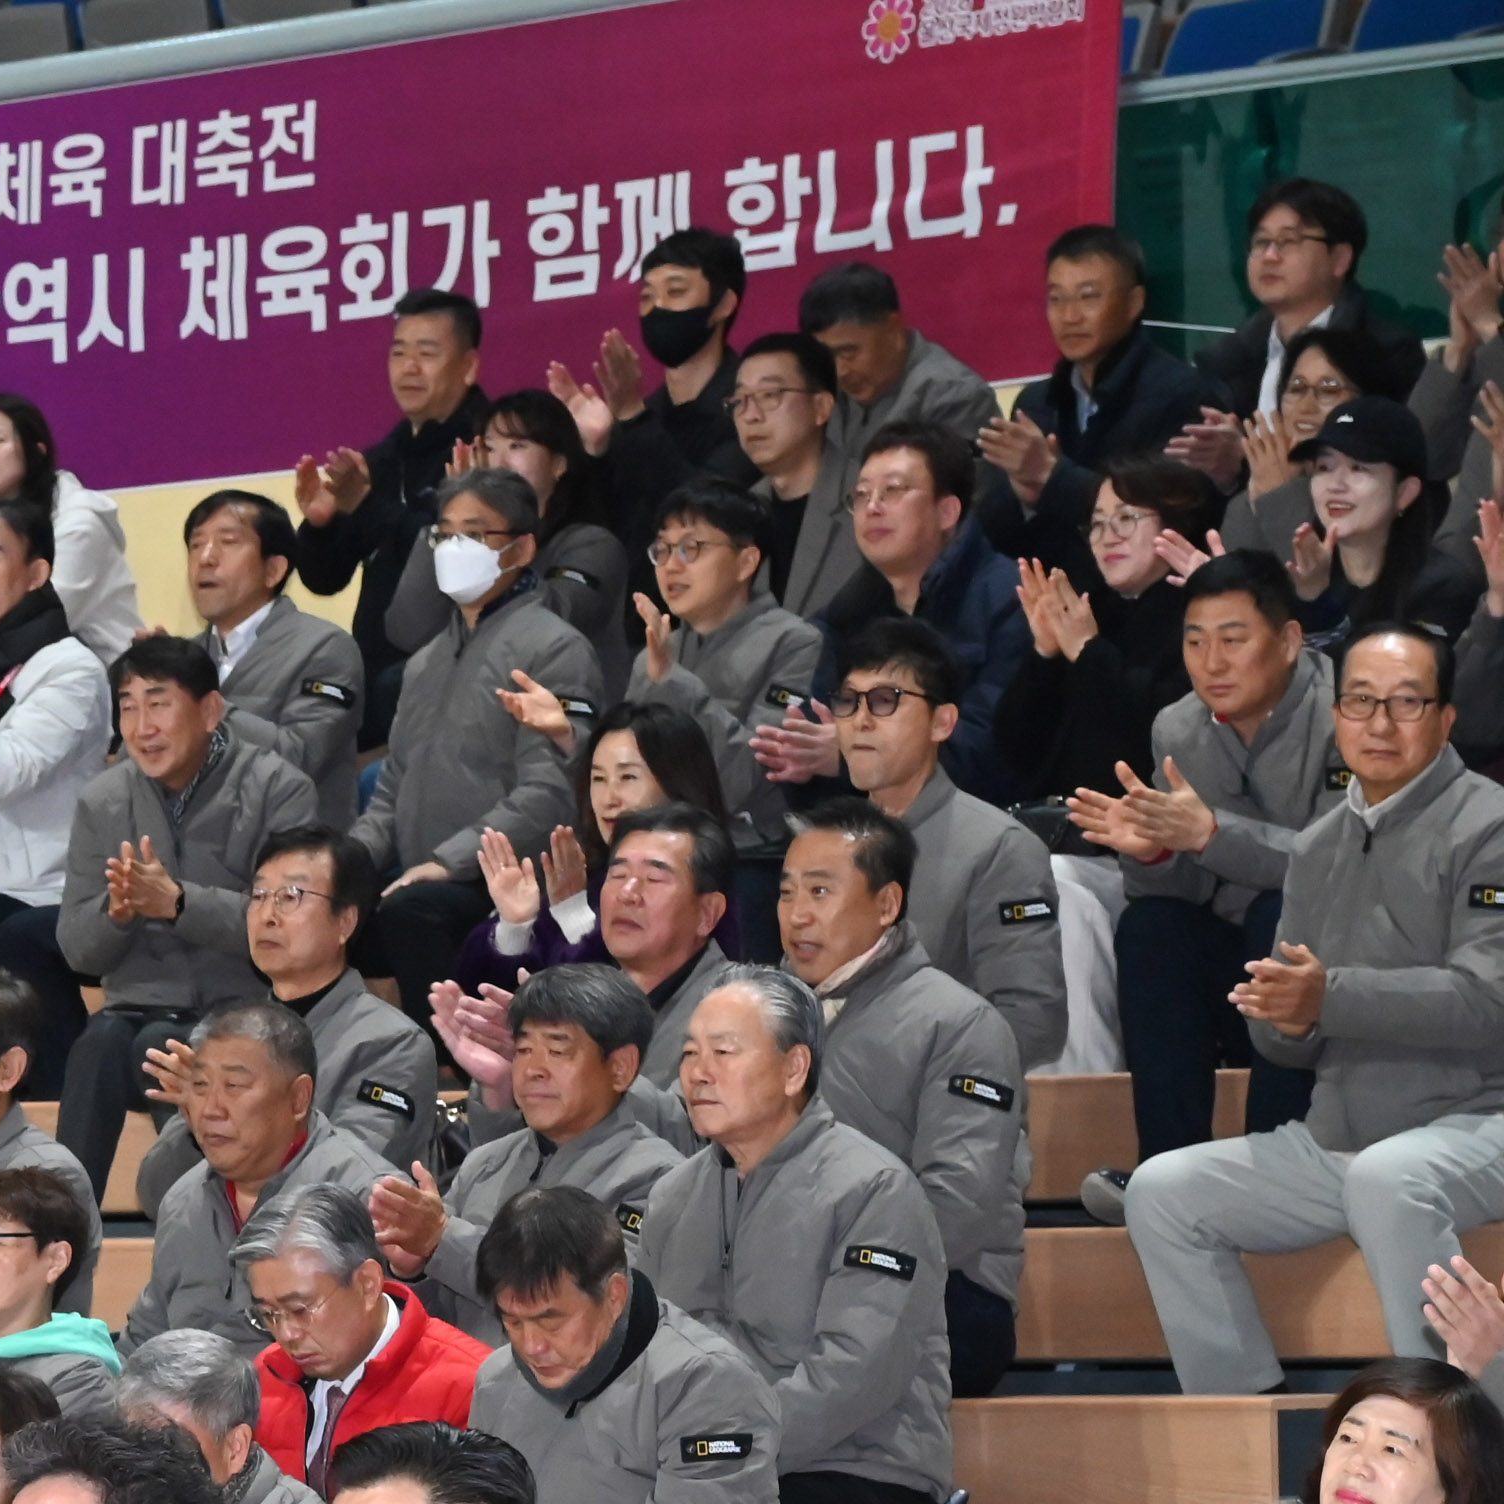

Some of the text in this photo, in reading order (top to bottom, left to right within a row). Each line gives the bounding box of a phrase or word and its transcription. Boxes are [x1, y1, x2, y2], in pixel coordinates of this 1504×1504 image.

[131, 101, 318, 206] 대축전
[180, 201, 501, 342] 체육회가
[527, 172, 692, 303] 함께
[724, 126, 1019, 273] 합니다.
